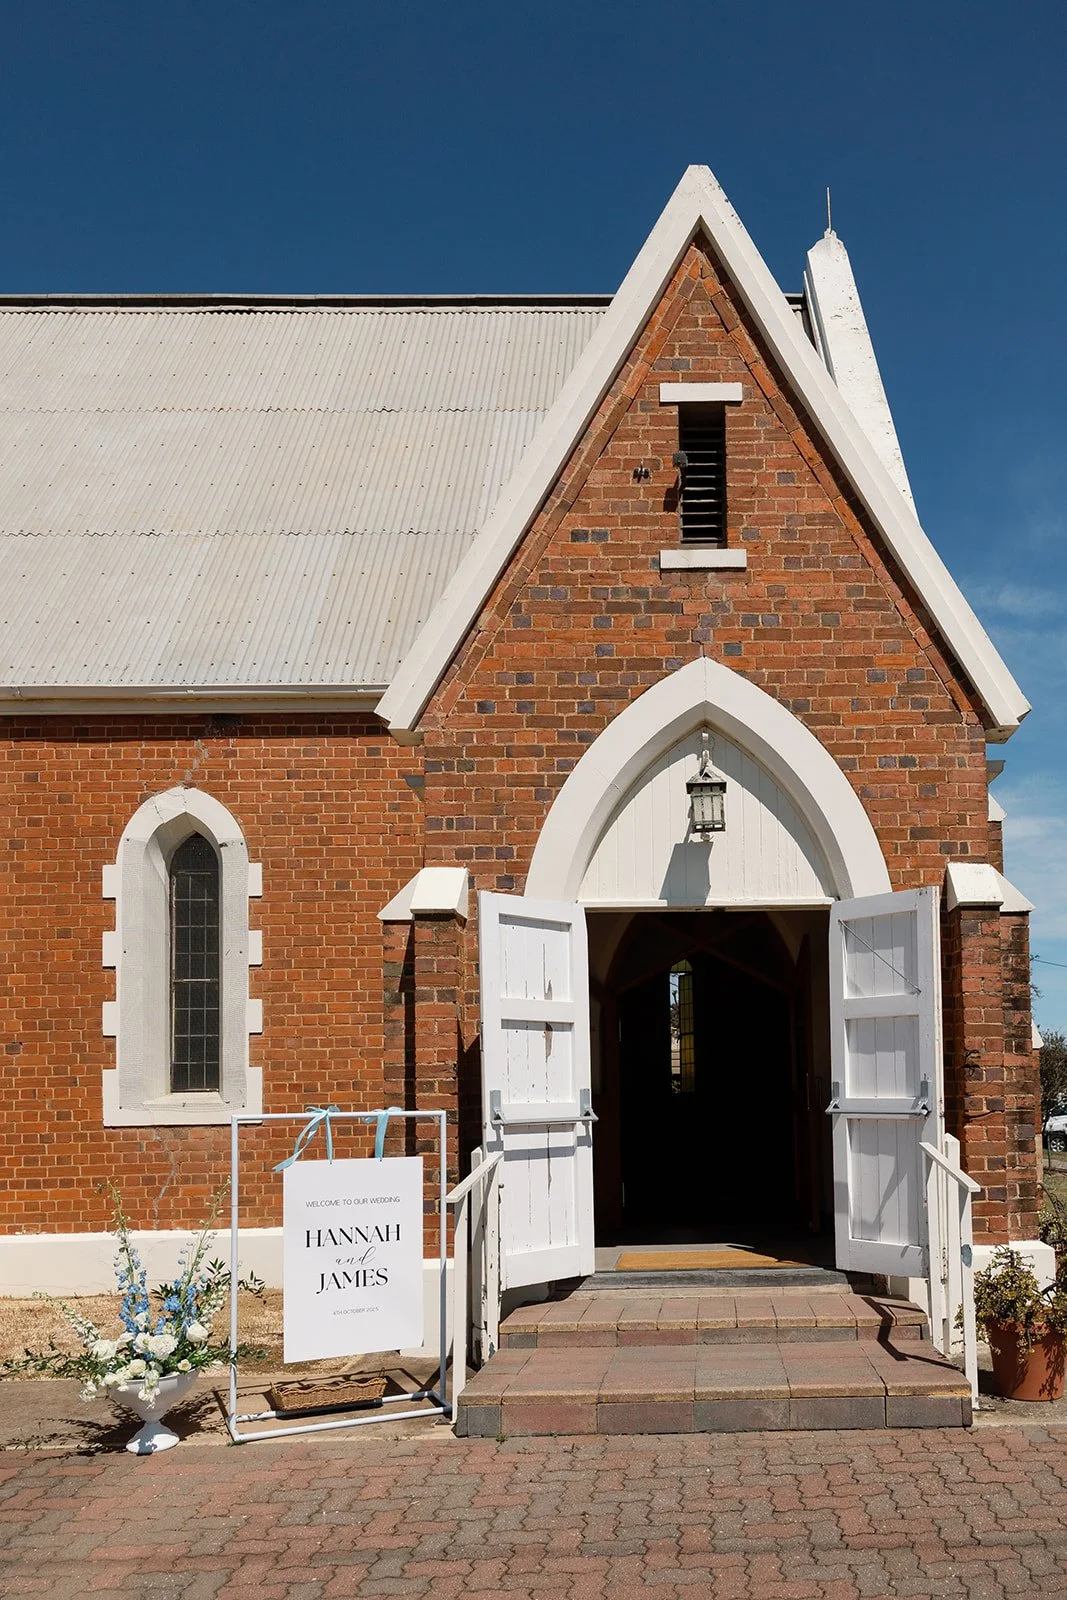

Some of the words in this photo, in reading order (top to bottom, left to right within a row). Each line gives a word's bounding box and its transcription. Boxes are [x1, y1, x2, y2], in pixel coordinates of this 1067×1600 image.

[305, 1199, 340, 1207] WELCOME
[343, 1198, 352, 1206] TO
[353, 1197, 368, 1205] OUR
[369, 1195, 400, 1204] WEDDING
[306, 1223, 400, 1248] HANNAH
[335, 1245, 377, 1265] and
[316, 1267, 388, 1294] JAMES
